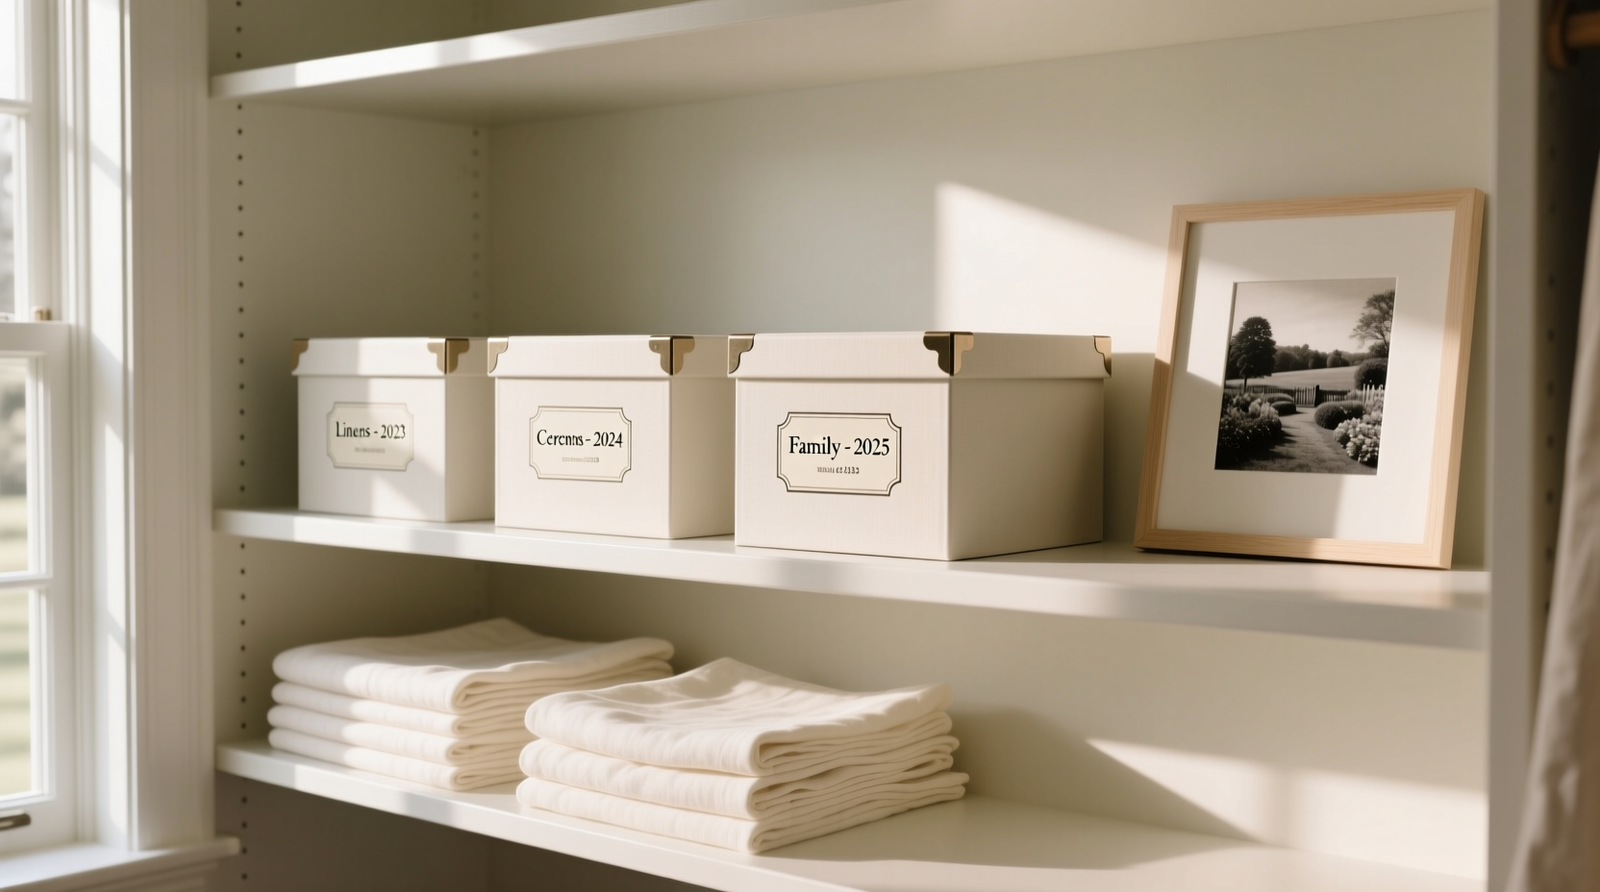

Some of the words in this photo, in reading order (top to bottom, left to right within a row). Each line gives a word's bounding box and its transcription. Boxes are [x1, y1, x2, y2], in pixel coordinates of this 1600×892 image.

[336, 421, 371, 438] Linens
[380, 424, 406, 439] 2023
[592, 431, 623, 448] 2024
[788, 435, 841, 461] Family
[853, 437, 890, 456] 2025
